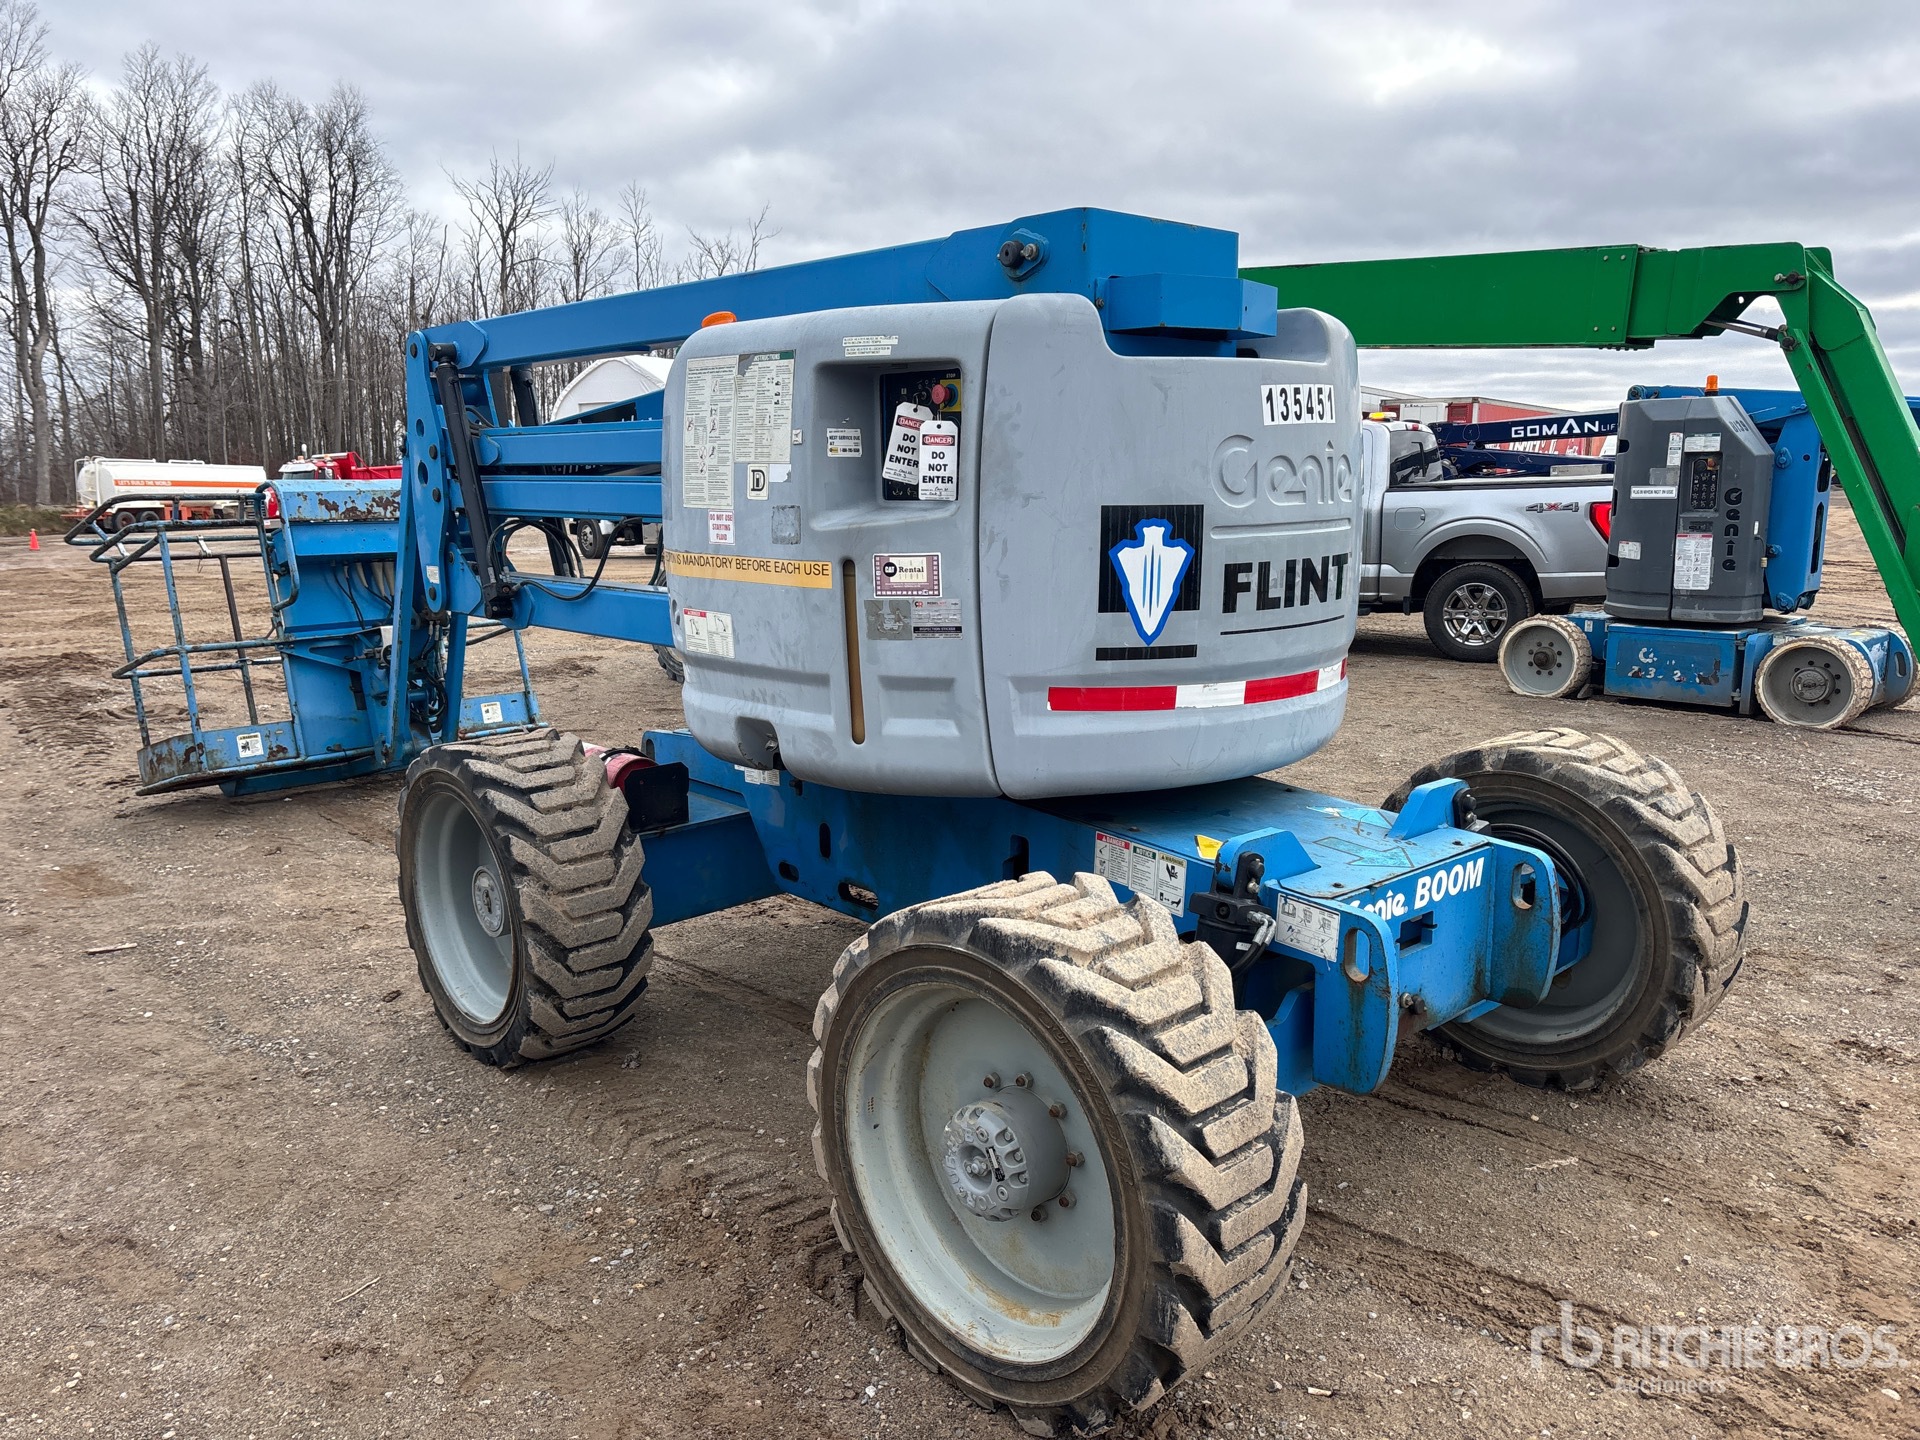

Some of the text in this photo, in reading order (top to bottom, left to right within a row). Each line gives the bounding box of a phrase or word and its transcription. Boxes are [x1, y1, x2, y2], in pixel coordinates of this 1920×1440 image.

[1266, 387, 1333, 422] 135451
[900, 417, 920, 428] DANGE
[1511, 418, 1599, 438] GOMAN
[902, 434, 916, 443] DO
[897, 445, 917, 455] NOT
[889, 455, 919, 468] ENTER
[1211, 434, 1353, 508] Genie
[1722, 488, 1742, 570] Genie
[683, 555, 733, 569] MANDATORY
[736, 559, 771, 572] BEFORE
[775, 562, 800, 574] EACH
[804, 564, 829, 576] USE
[1222, 553, 1348, 614] FLINT
[1107, 836, 1125, 847] DANGER
[1136, 848, 1153, 857] NOTICE
[1414, 856, 1484, 910] BOOM
